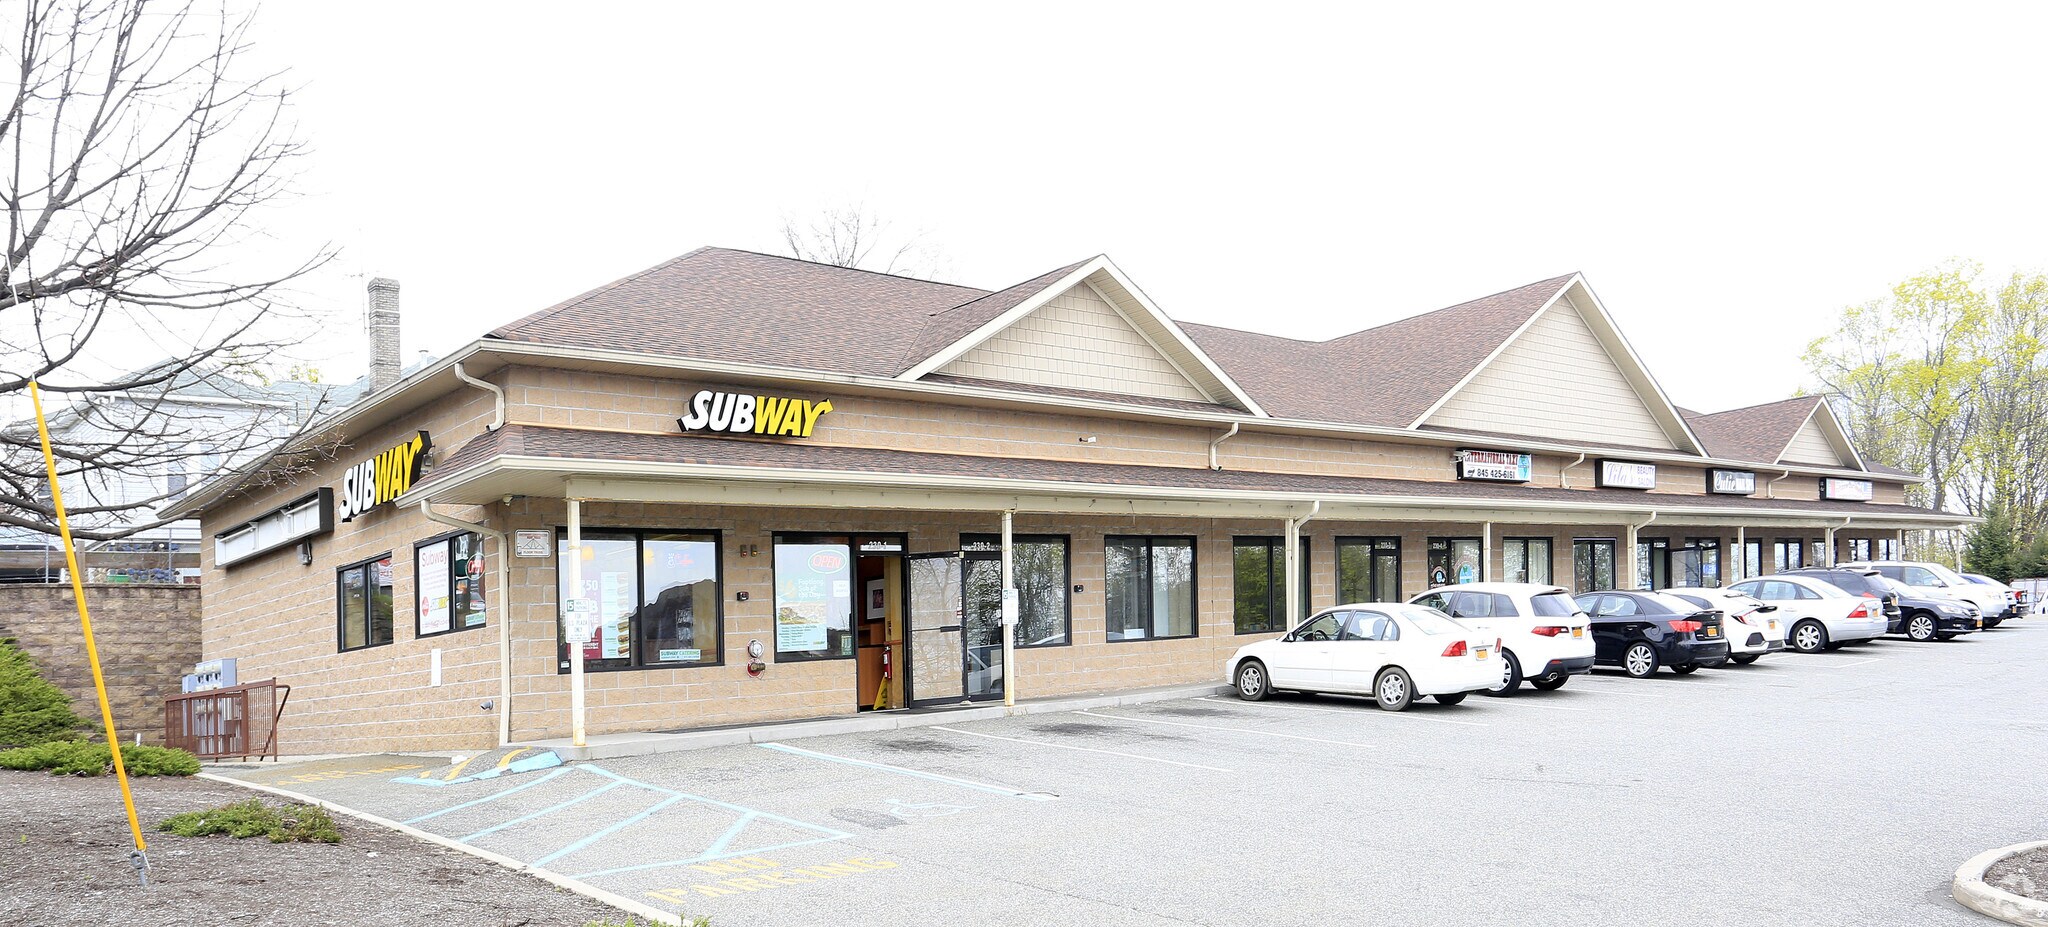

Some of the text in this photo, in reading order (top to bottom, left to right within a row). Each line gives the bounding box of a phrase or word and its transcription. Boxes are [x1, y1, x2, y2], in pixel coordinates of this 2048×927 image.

[680, 390, 834, 437] SUBWAY
[339, 431, 423, 519] SUBWAY
[1476, 468, 1489, 478] 845
[422, 548, 450, 567] Subway
[812, 554, 842, 569] OPEN
[567, 601, 574, 611] 15
[688, 856, 782, 876] NO
[644, 856, 900, 905] PARKING
